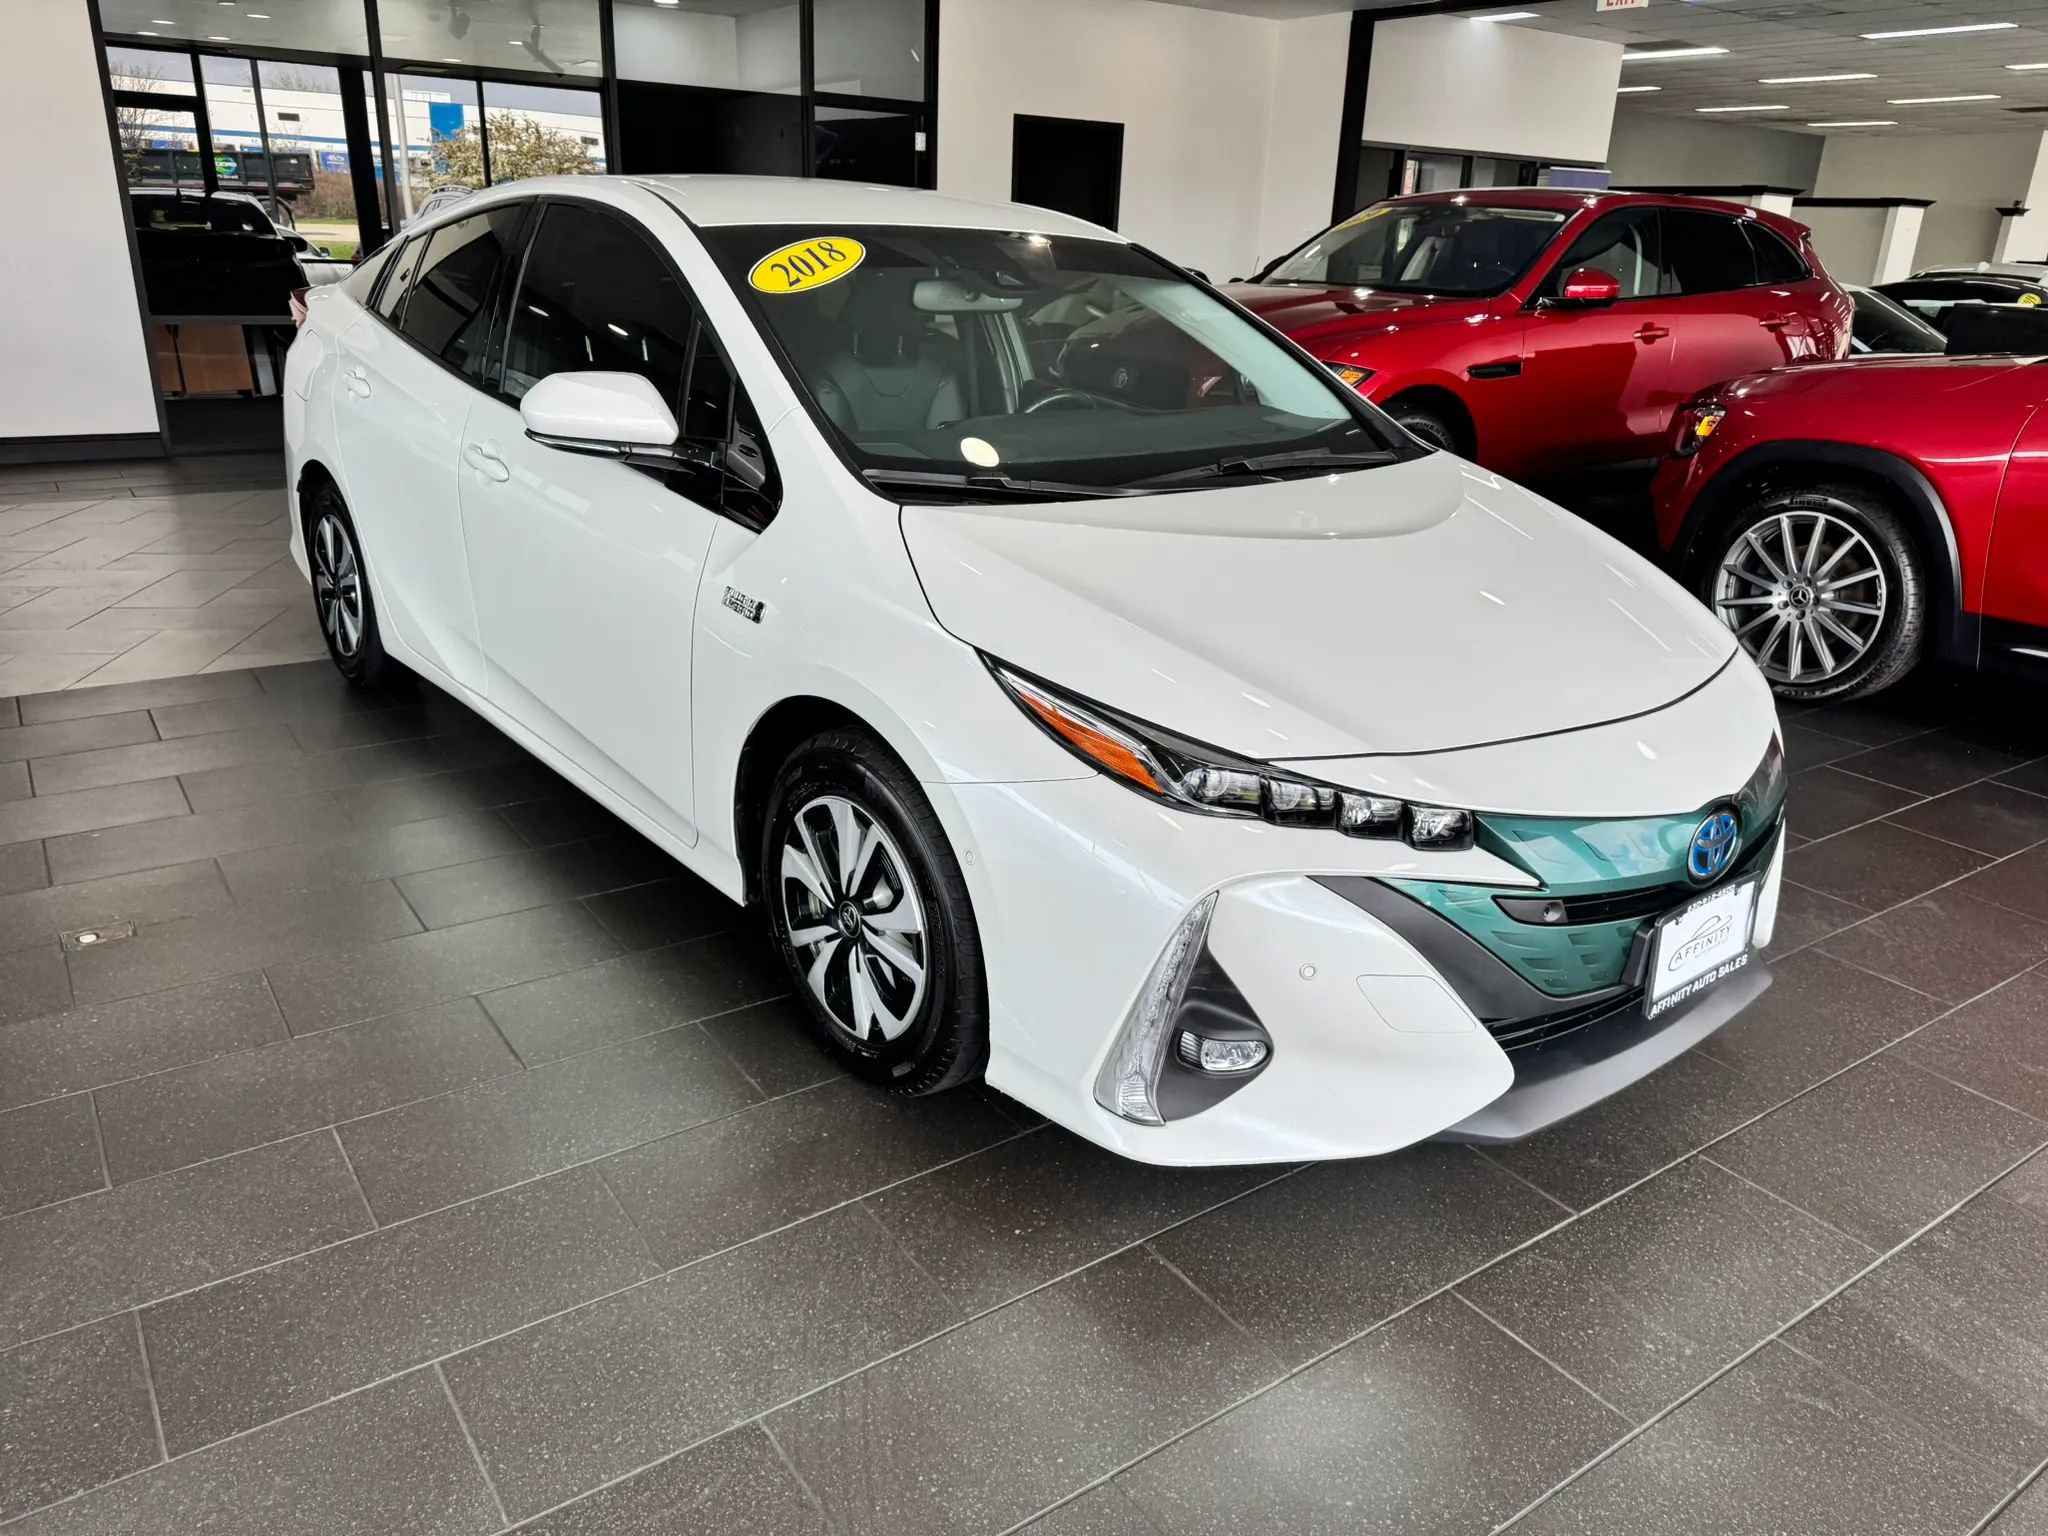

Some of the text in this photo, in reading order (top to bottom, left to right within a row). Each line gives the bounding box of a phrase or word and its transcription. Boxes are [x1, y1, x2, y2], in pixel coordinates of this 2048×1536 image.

[770, 240, 847, 288] 2018
[1674, 924, 1732, 963] AFFINITY
[1650, 954, 1748, 1017] AFFINITY AUTO SALES
